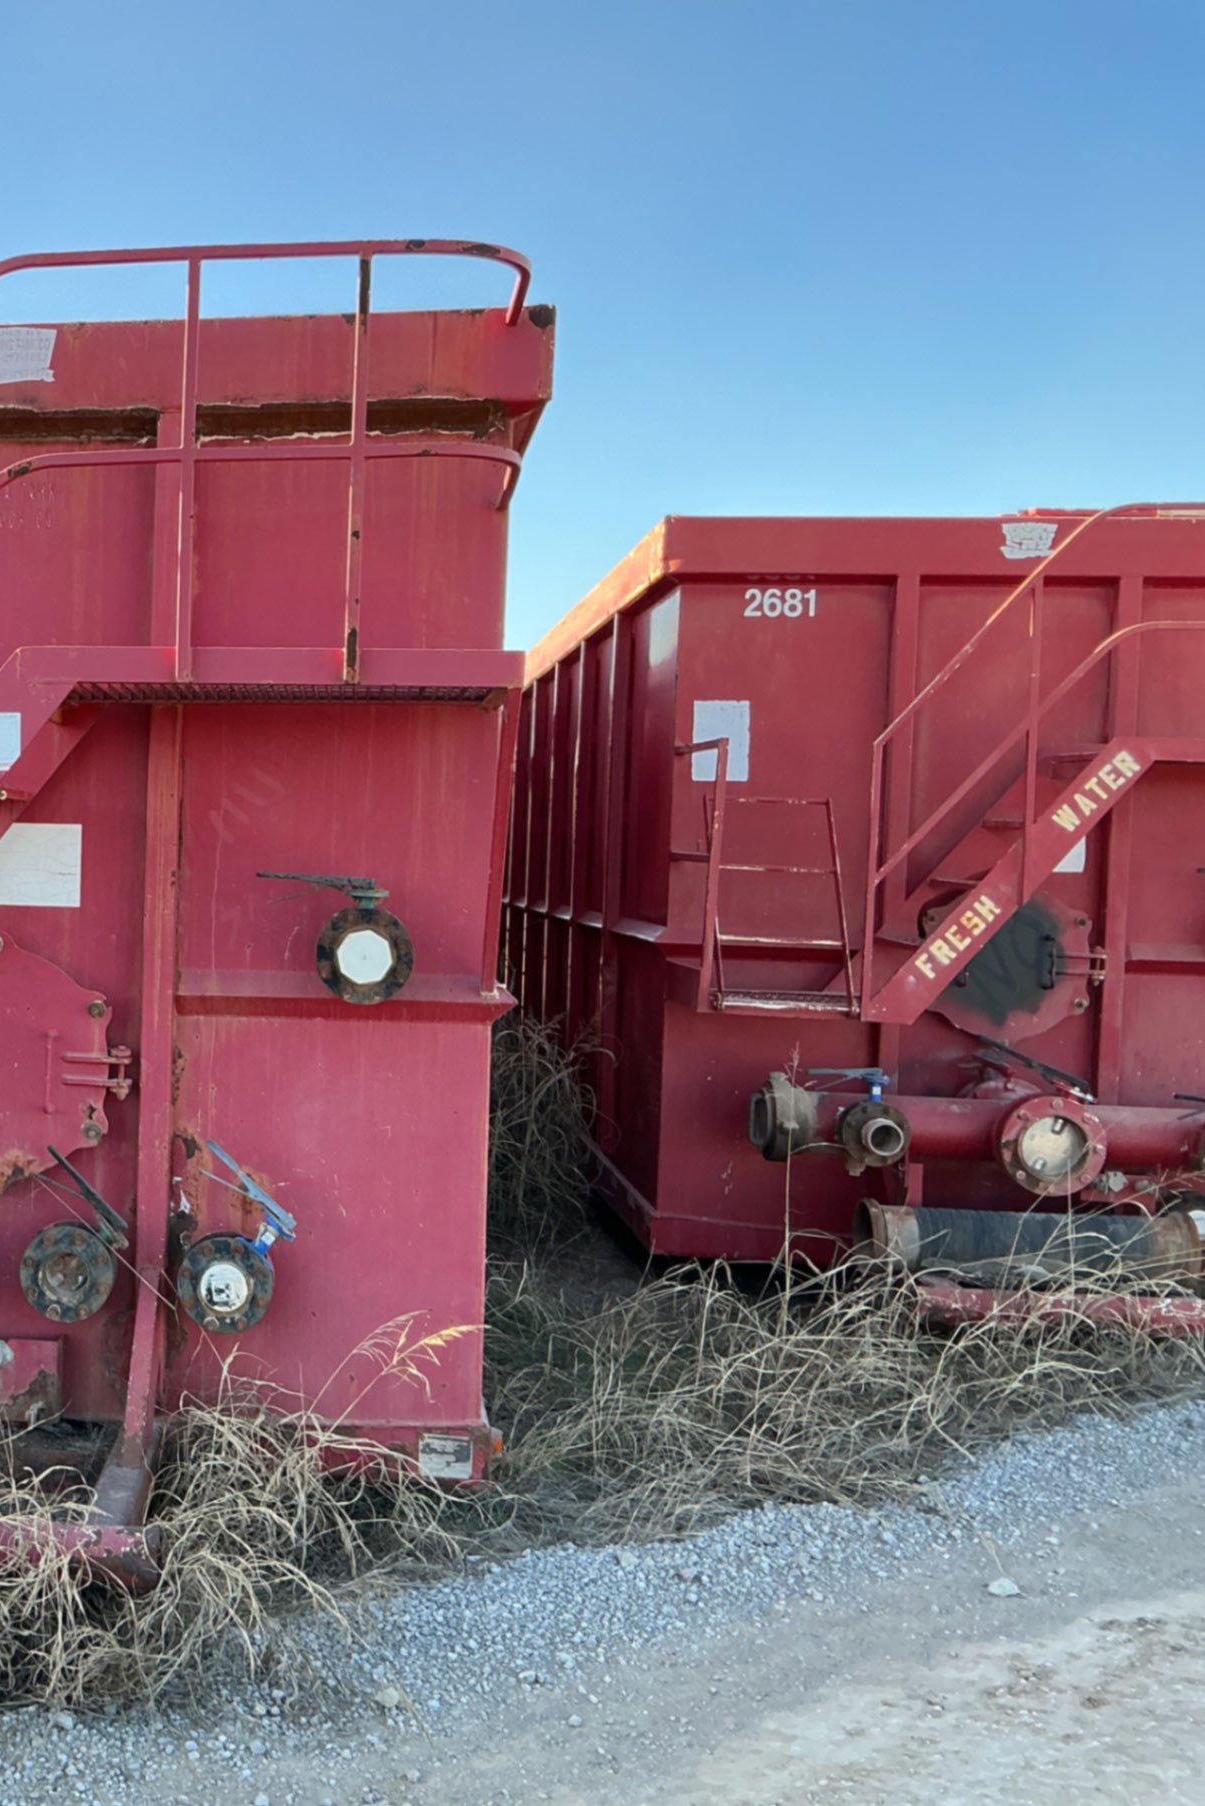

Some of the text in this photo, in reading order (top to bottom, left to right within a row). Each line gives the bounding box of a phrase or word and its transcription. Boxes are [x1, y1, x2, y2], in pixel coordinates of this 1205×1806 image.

[743, 587, 817, 618] 2681
[1051, 750, 1141, 832] WATER
[914, 894, 1002, 979] FRESH
